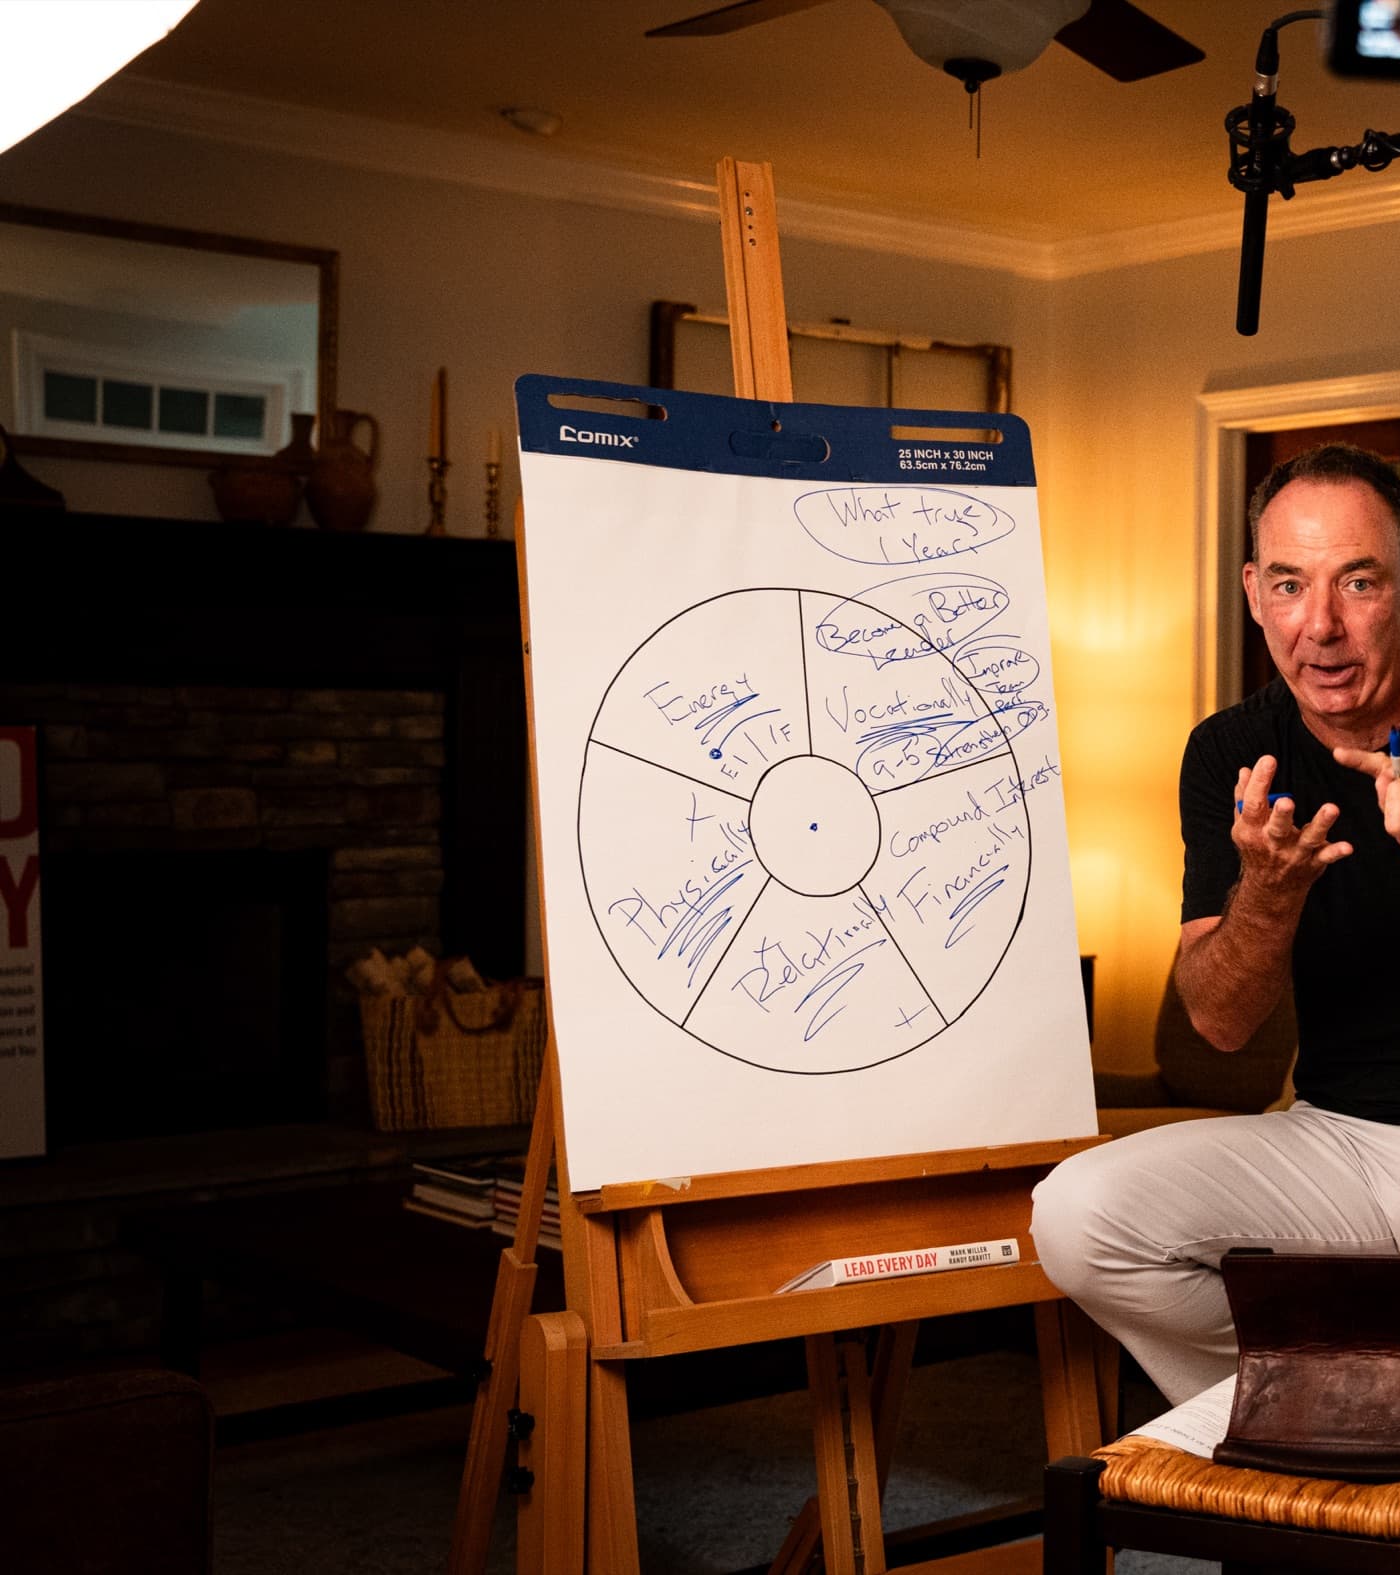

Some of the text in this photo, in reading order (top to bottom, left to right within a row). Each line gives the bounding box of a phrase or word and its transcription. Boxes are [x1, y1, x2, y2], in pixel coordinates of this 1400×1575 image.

[898, 449, 994, 461] 25 INCH x 30 INCH
[900, 460, 938, 470] 63.5cm
[950, 461, 987, 471] 76.2cm
[826, 487, 901, 527] What
[928, 589, 1003, 623] Better
[643, 672, 755, 726] Energy
[825, 677, 981, 734] Vocationally
[889, 754, 1061, 858] Compound Interest
[608, 819, 753, 947] Physically
[896, 823, 1025, 925] Financially
[844, 1252, 938, 1278] LEAD EVERY DAY
[949, 1253, 991, 1265] RANDY GRAVITT
[950, 1246, 987, 1257] MARK MILLER
